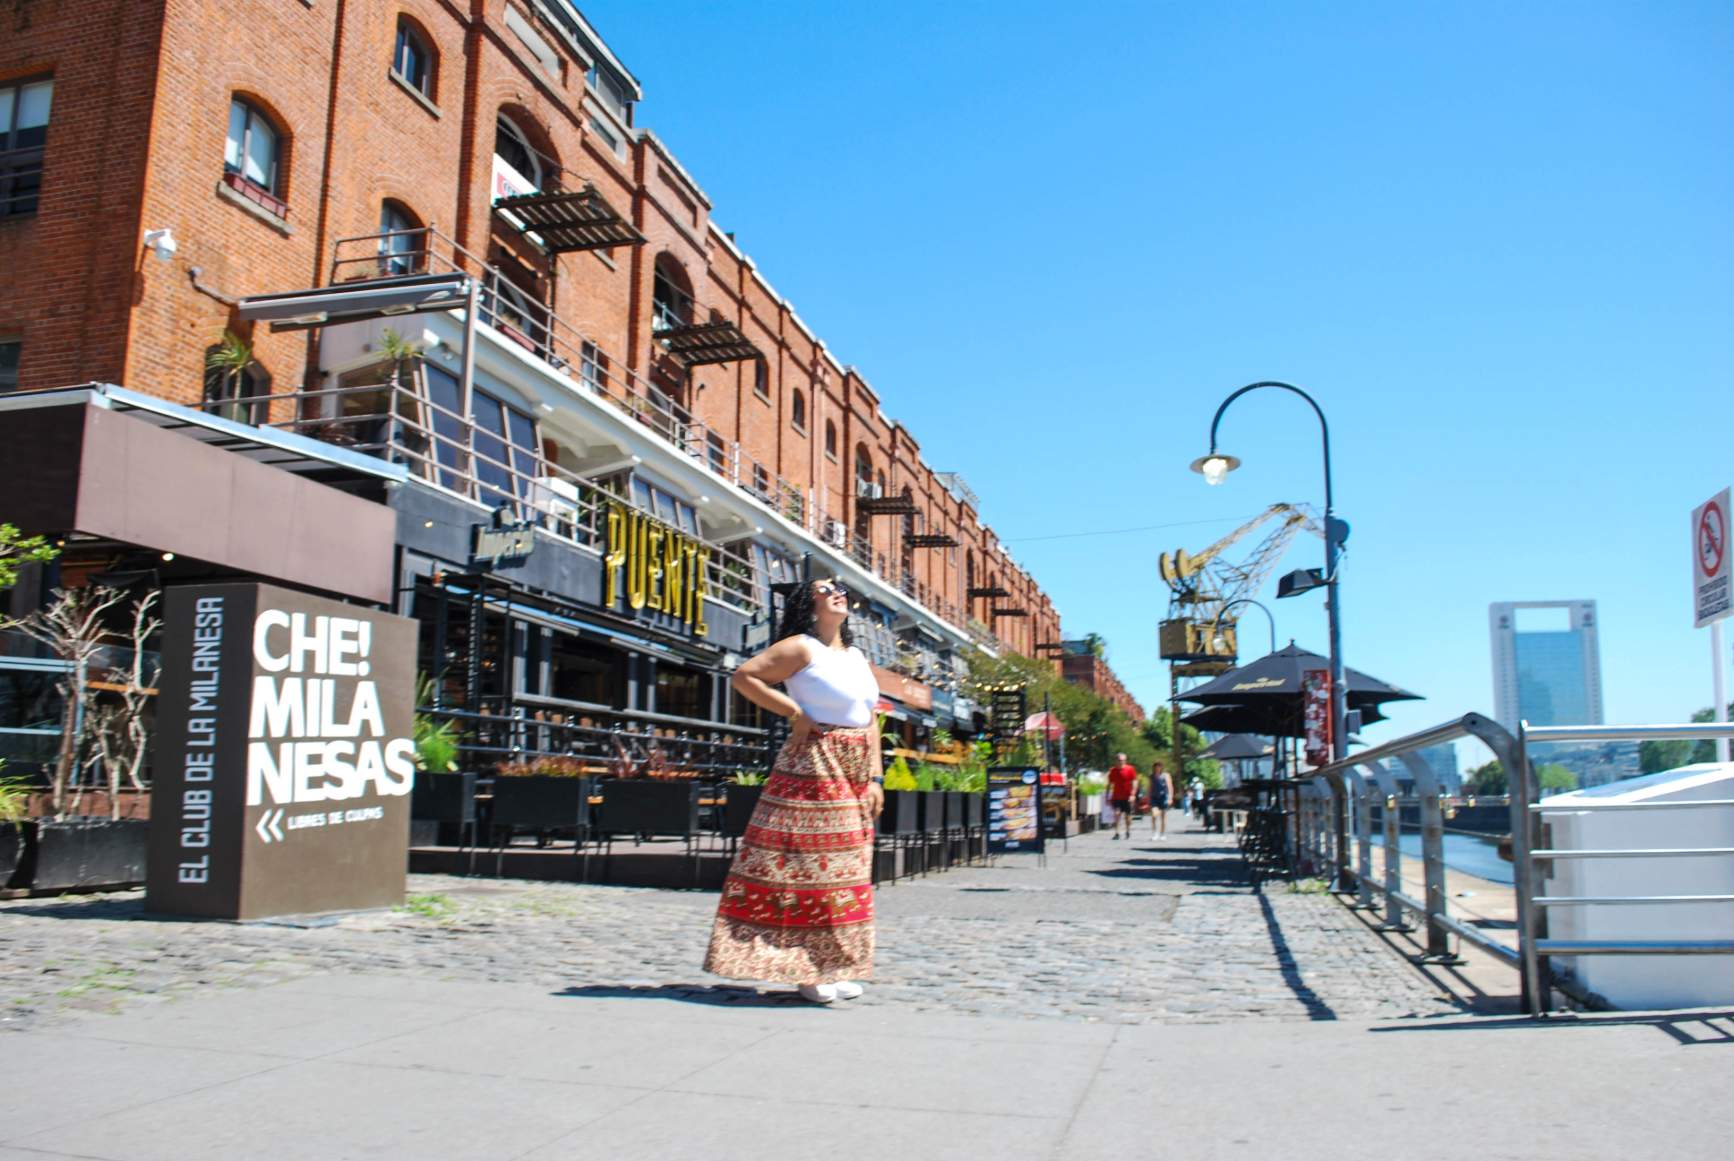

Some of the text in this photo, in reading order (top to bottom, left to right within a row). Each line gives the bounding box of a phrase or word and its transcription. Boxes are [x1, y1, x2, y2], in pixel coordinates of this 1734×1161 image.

[606, 501, 710, 635] PUENTE
[252, 608, 372, 676] CHE!
[178, 597, 224, 883] EL CLUB DE LA MILANESA
[248, 676, 385, 738] MILA
[246, 738, 416, 806] NESAS
